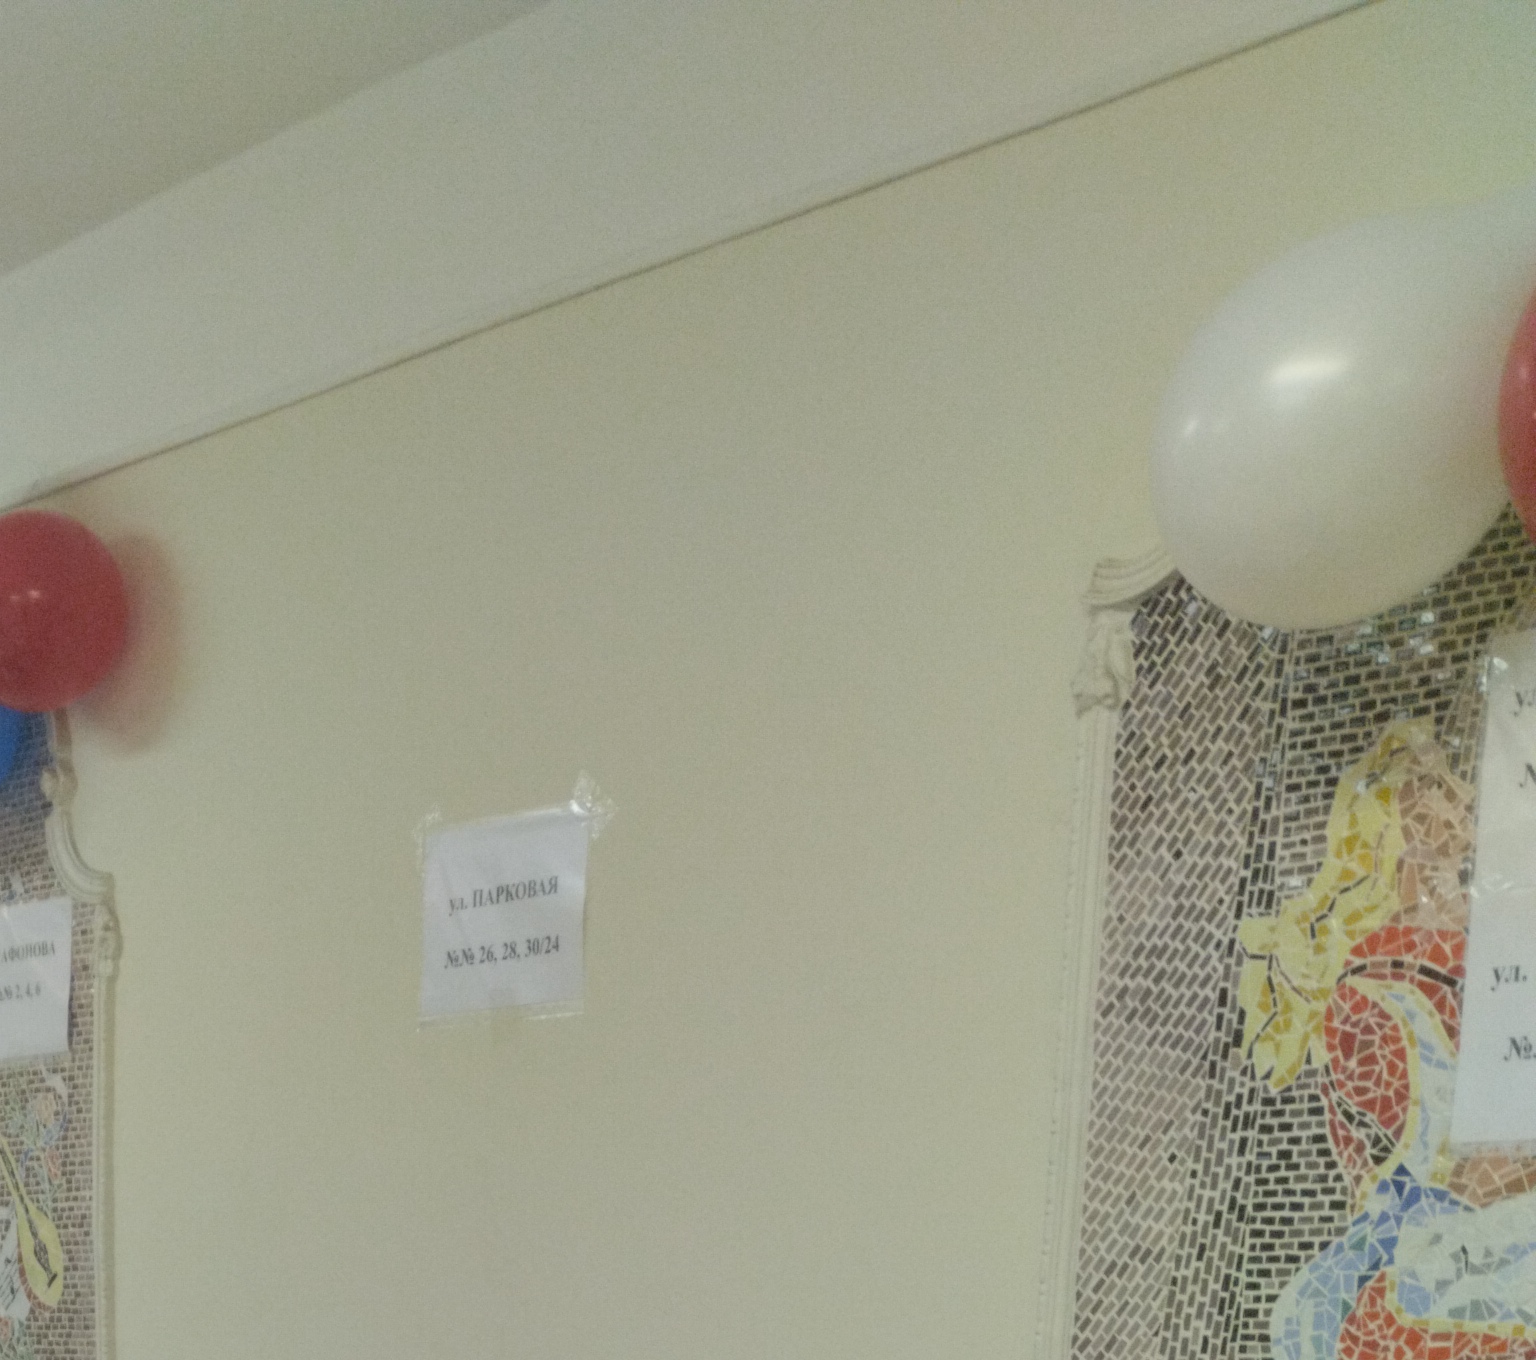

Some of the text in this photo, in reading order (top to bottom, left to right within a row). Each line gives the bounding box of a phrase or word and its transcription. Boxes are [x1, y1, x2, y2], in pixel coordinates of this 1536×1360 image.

[448, 874, 560, 917] ул. ПАРКОВАЯ
[478, 943, 498, 966] 26,
[524, 933, 561, 959] 30/24
[1491, 964, 1527, 992] ул.
